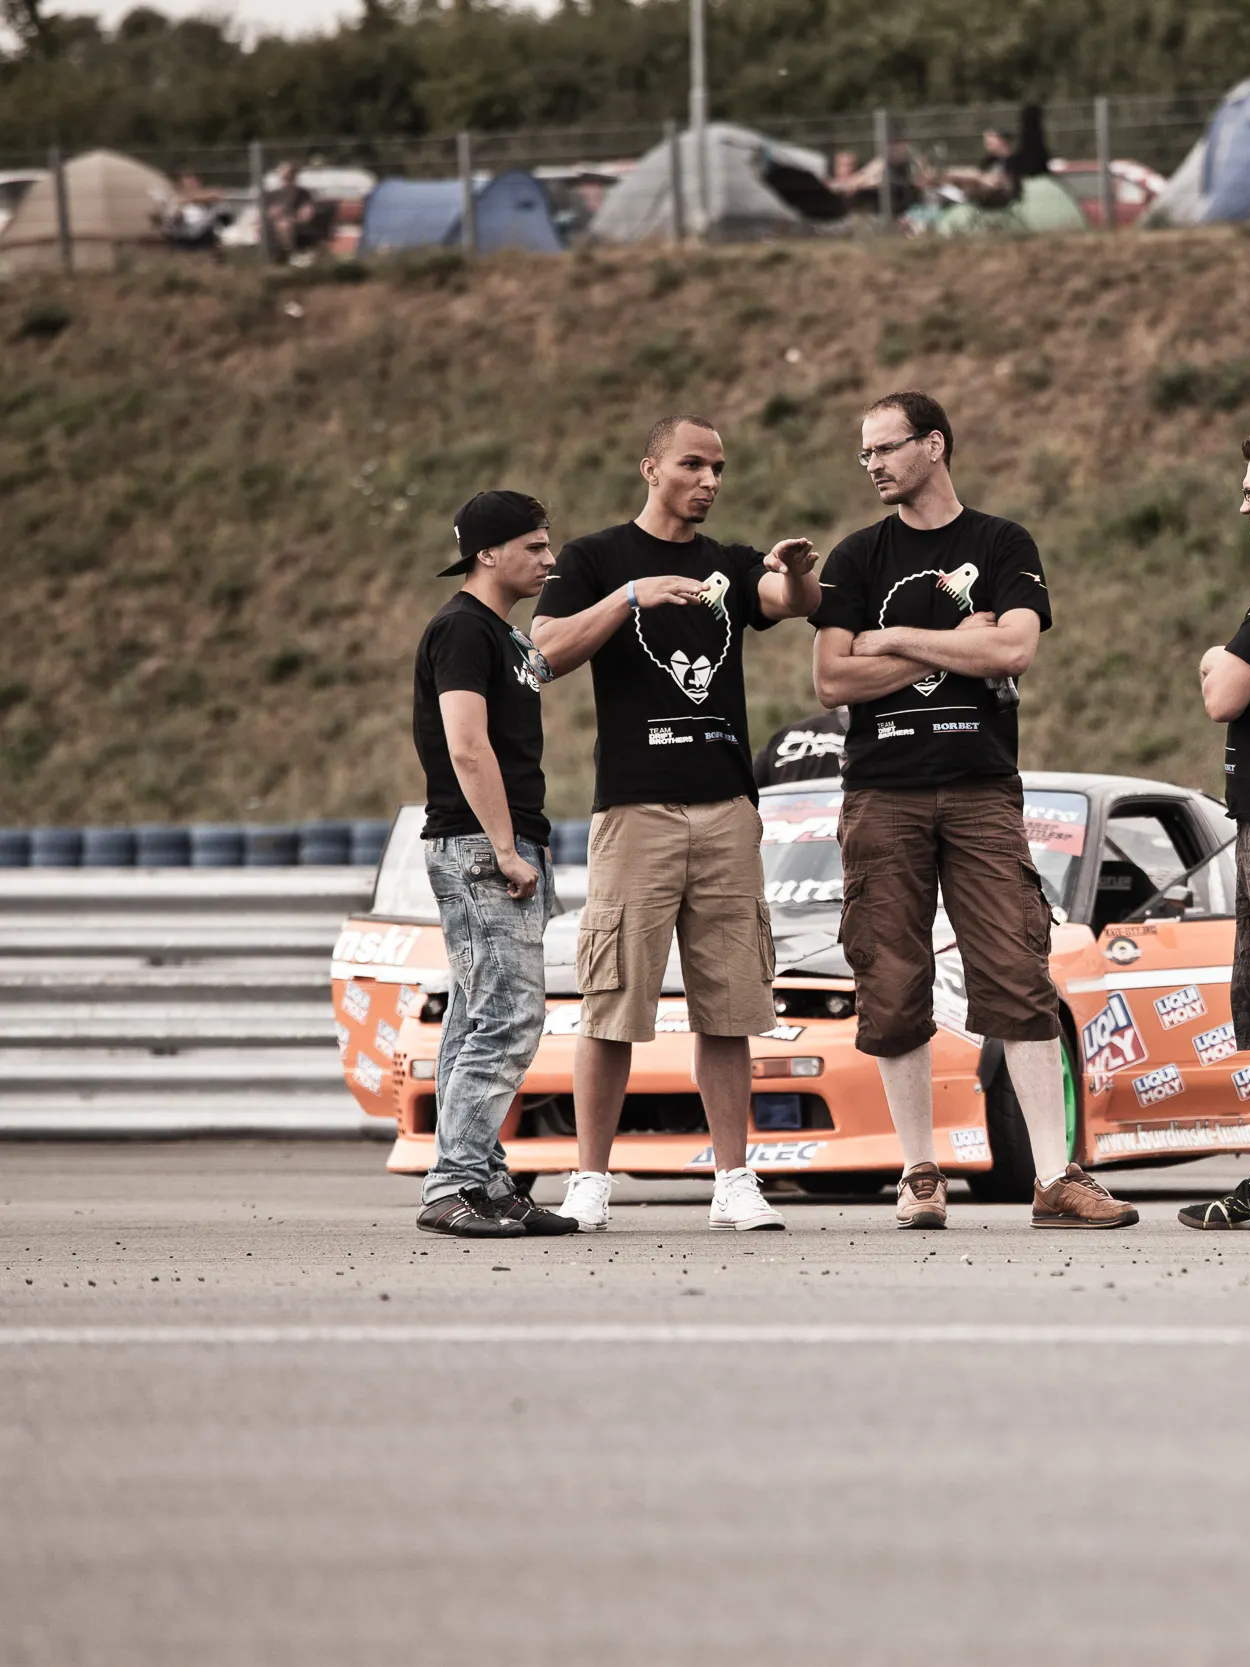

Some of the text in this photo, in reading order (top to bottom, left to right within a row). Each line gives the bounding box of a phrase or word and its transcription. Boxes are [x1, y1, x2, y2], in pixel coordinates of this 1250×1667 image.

[877, 720, 894, 728] TEAM
[932, 722, 979, 731] BORBET
[649, 736, 693, 745] BROTHERS
[332, 923, 423, 965] nski
[1156, 987, 1199, 1014] LIQUI
[1162, 1001, 1204, 1028] MOLY
[1135, 1066, 1178, 1092] LIQUI
[1140, 1079, 1181, 1105] MOLY
